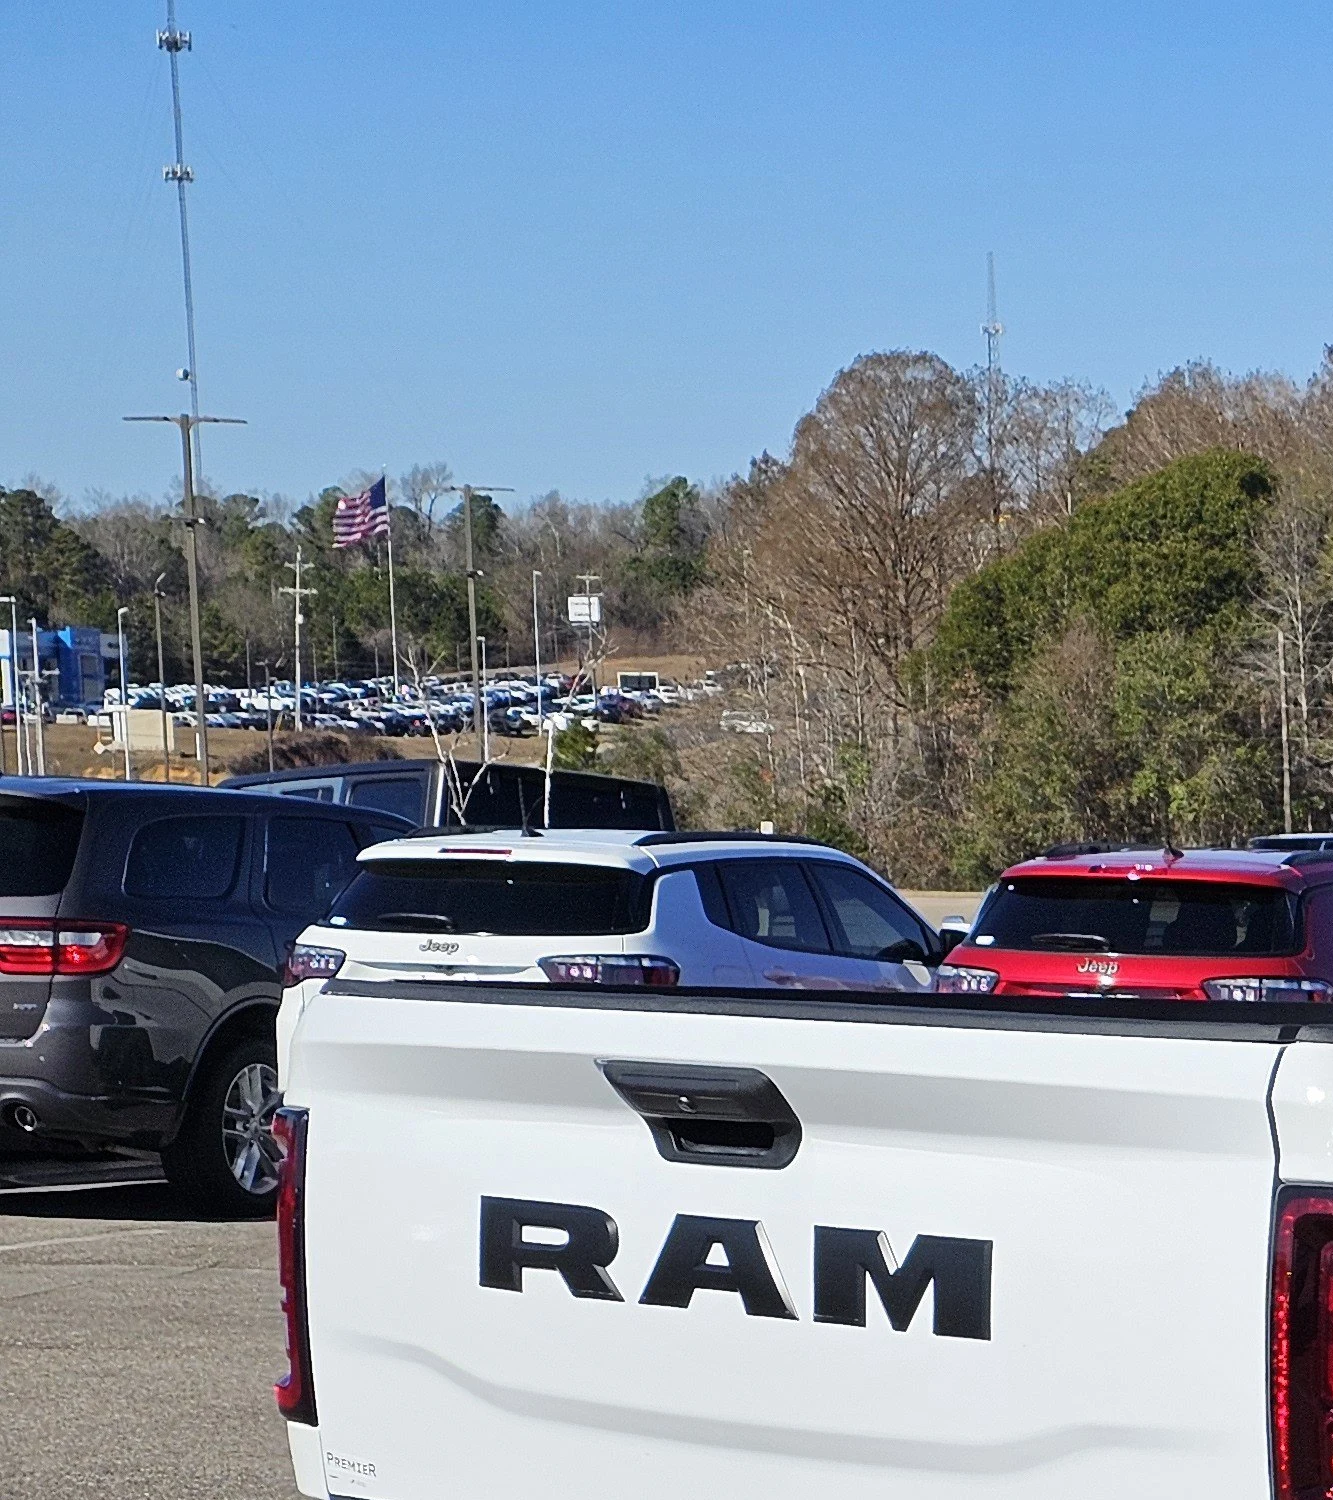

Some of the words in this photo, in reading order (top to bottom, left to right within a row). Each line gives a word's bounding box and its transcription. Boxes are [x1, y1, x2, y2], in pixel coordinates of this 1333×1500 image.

[419, 939, 460, 955] Jeep
[1077, 957, 1119, 975] Jeep
[479, 1195, 993, 1342] RAM
[326, 1451, 377, 1478] PREMIER
